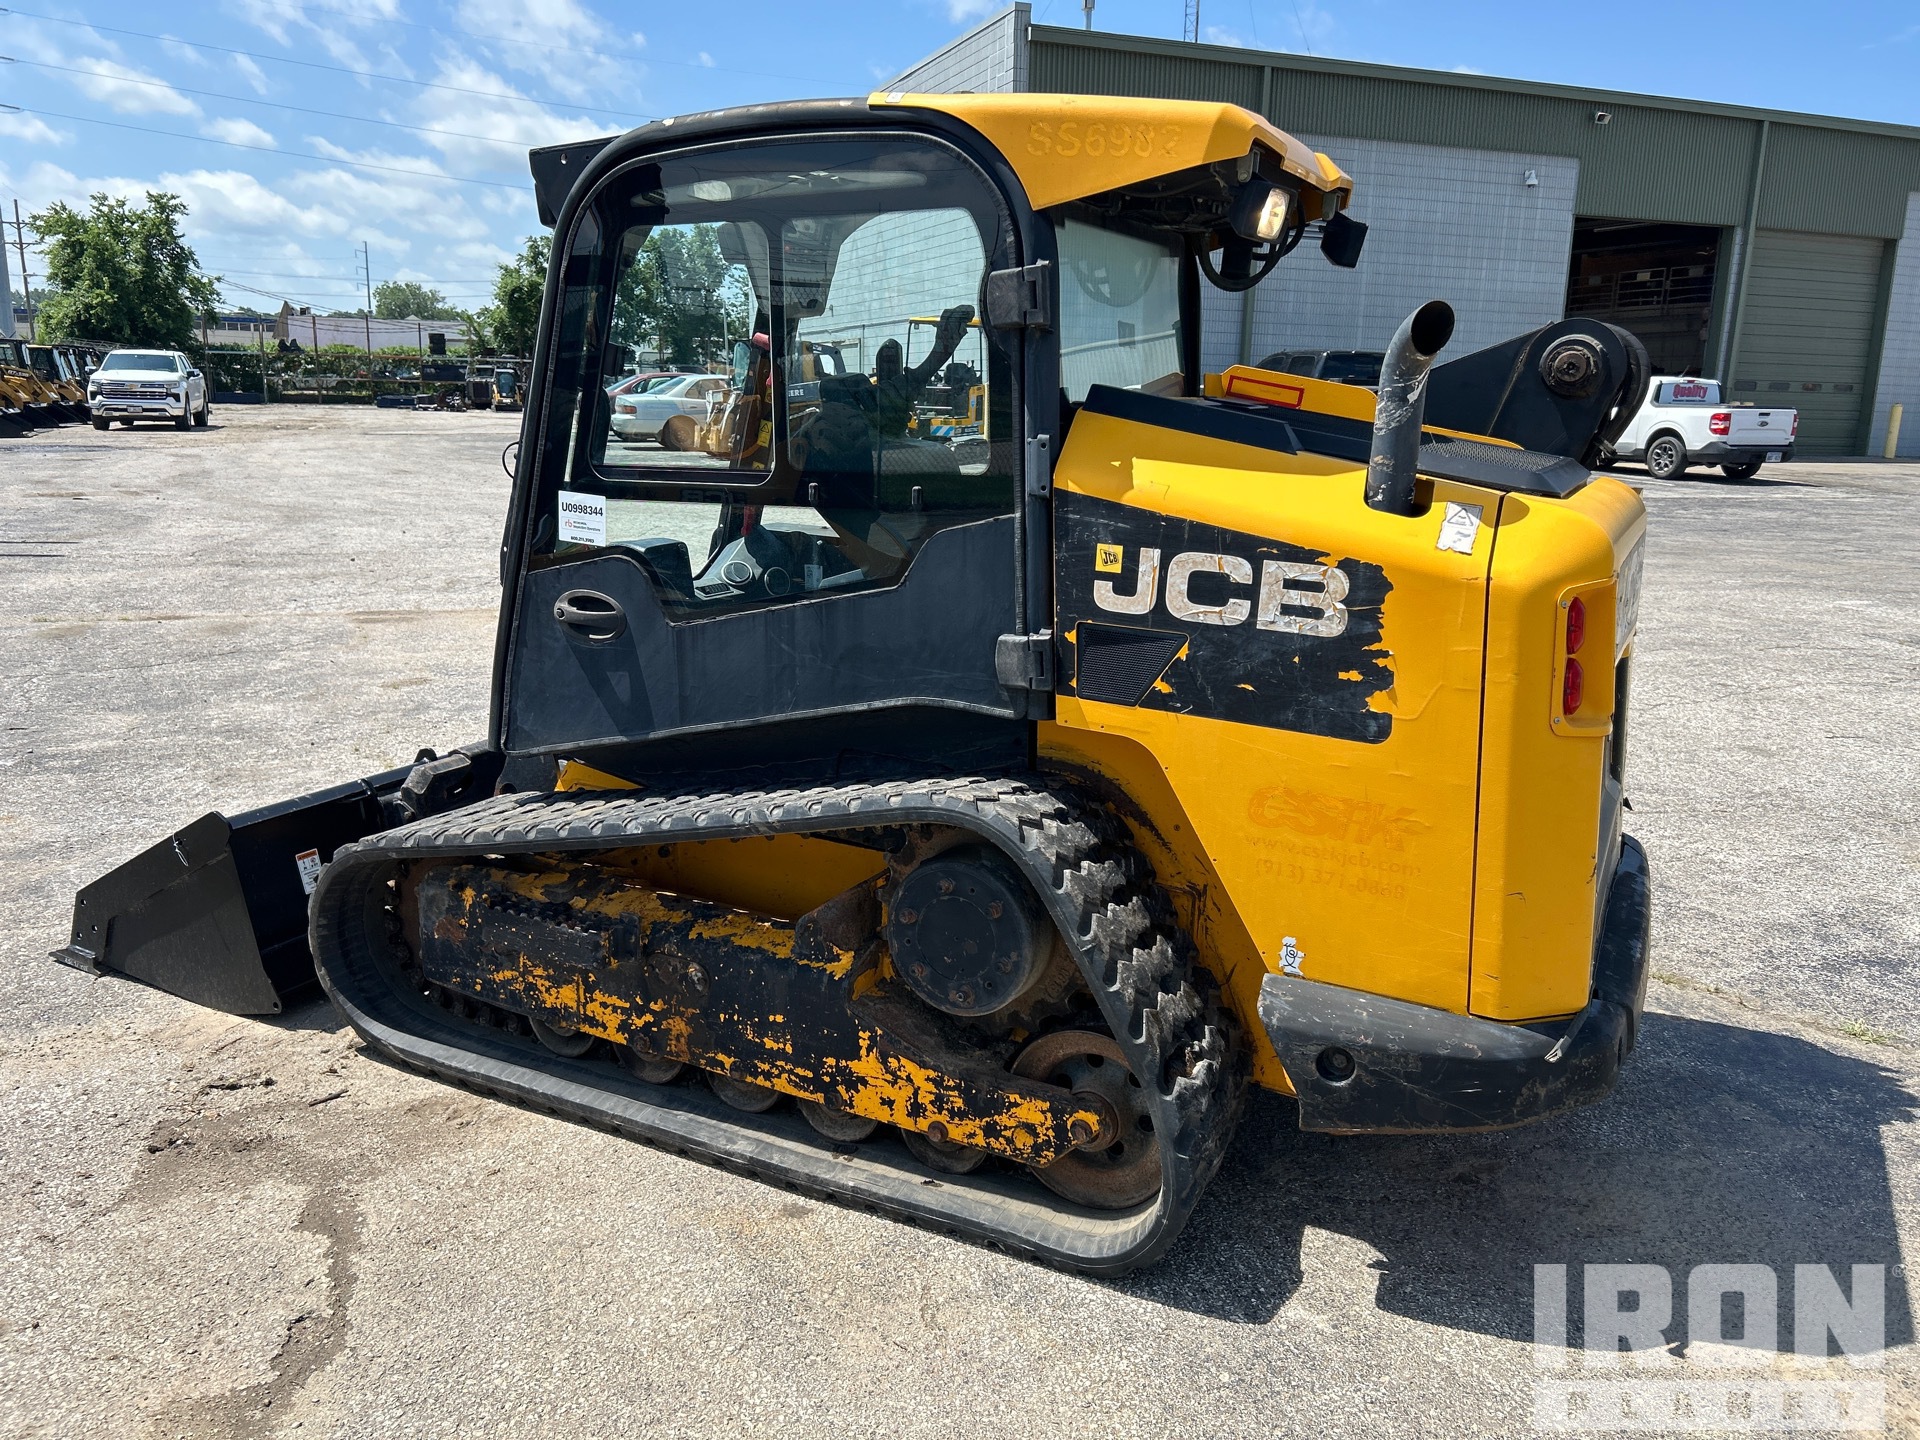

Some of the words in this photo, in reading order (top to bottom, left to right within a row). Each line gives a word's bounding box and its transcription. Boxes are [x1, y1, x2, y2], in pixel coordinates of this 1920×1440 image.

[1672, 384, 1709, 399] Quality
[561, 502, 603, 516] U0998344
[1103, 551, 1118, 565] JCB
[1093, 547, 1350, 637] JCB
